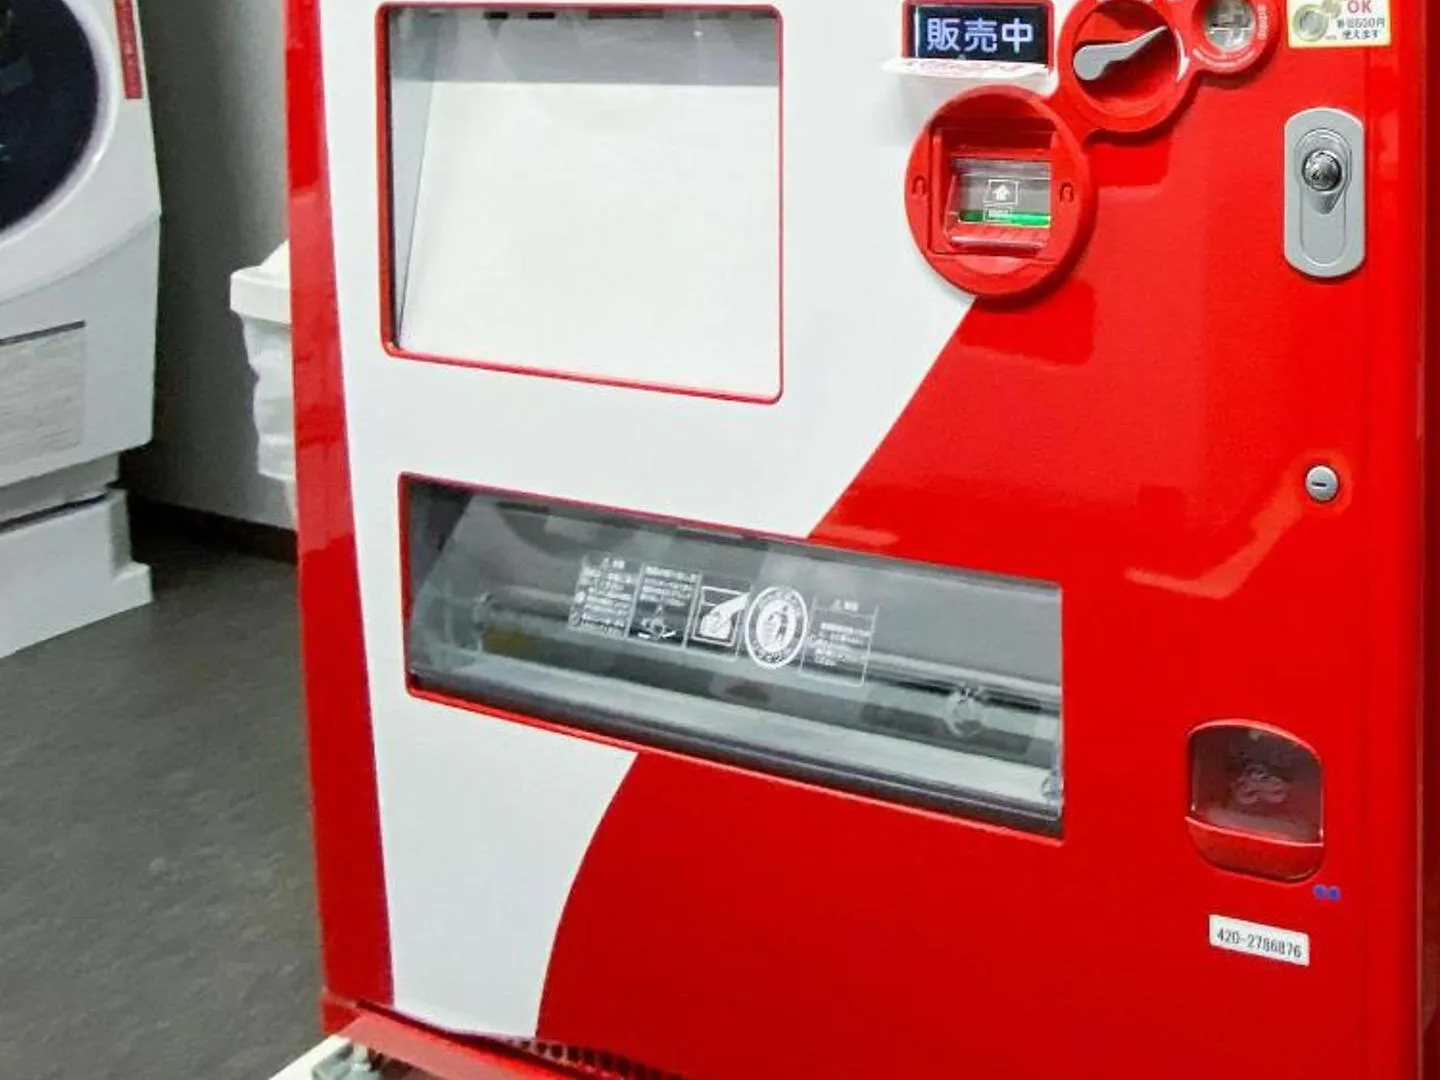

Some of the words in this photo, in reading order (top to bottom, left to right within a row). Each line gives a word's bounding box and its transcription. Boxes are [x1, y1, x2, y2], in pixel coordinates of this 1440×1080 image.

[926, 17, 1034, 54] 販売中
[1217, 927, 1302, 956] 420-2786876
